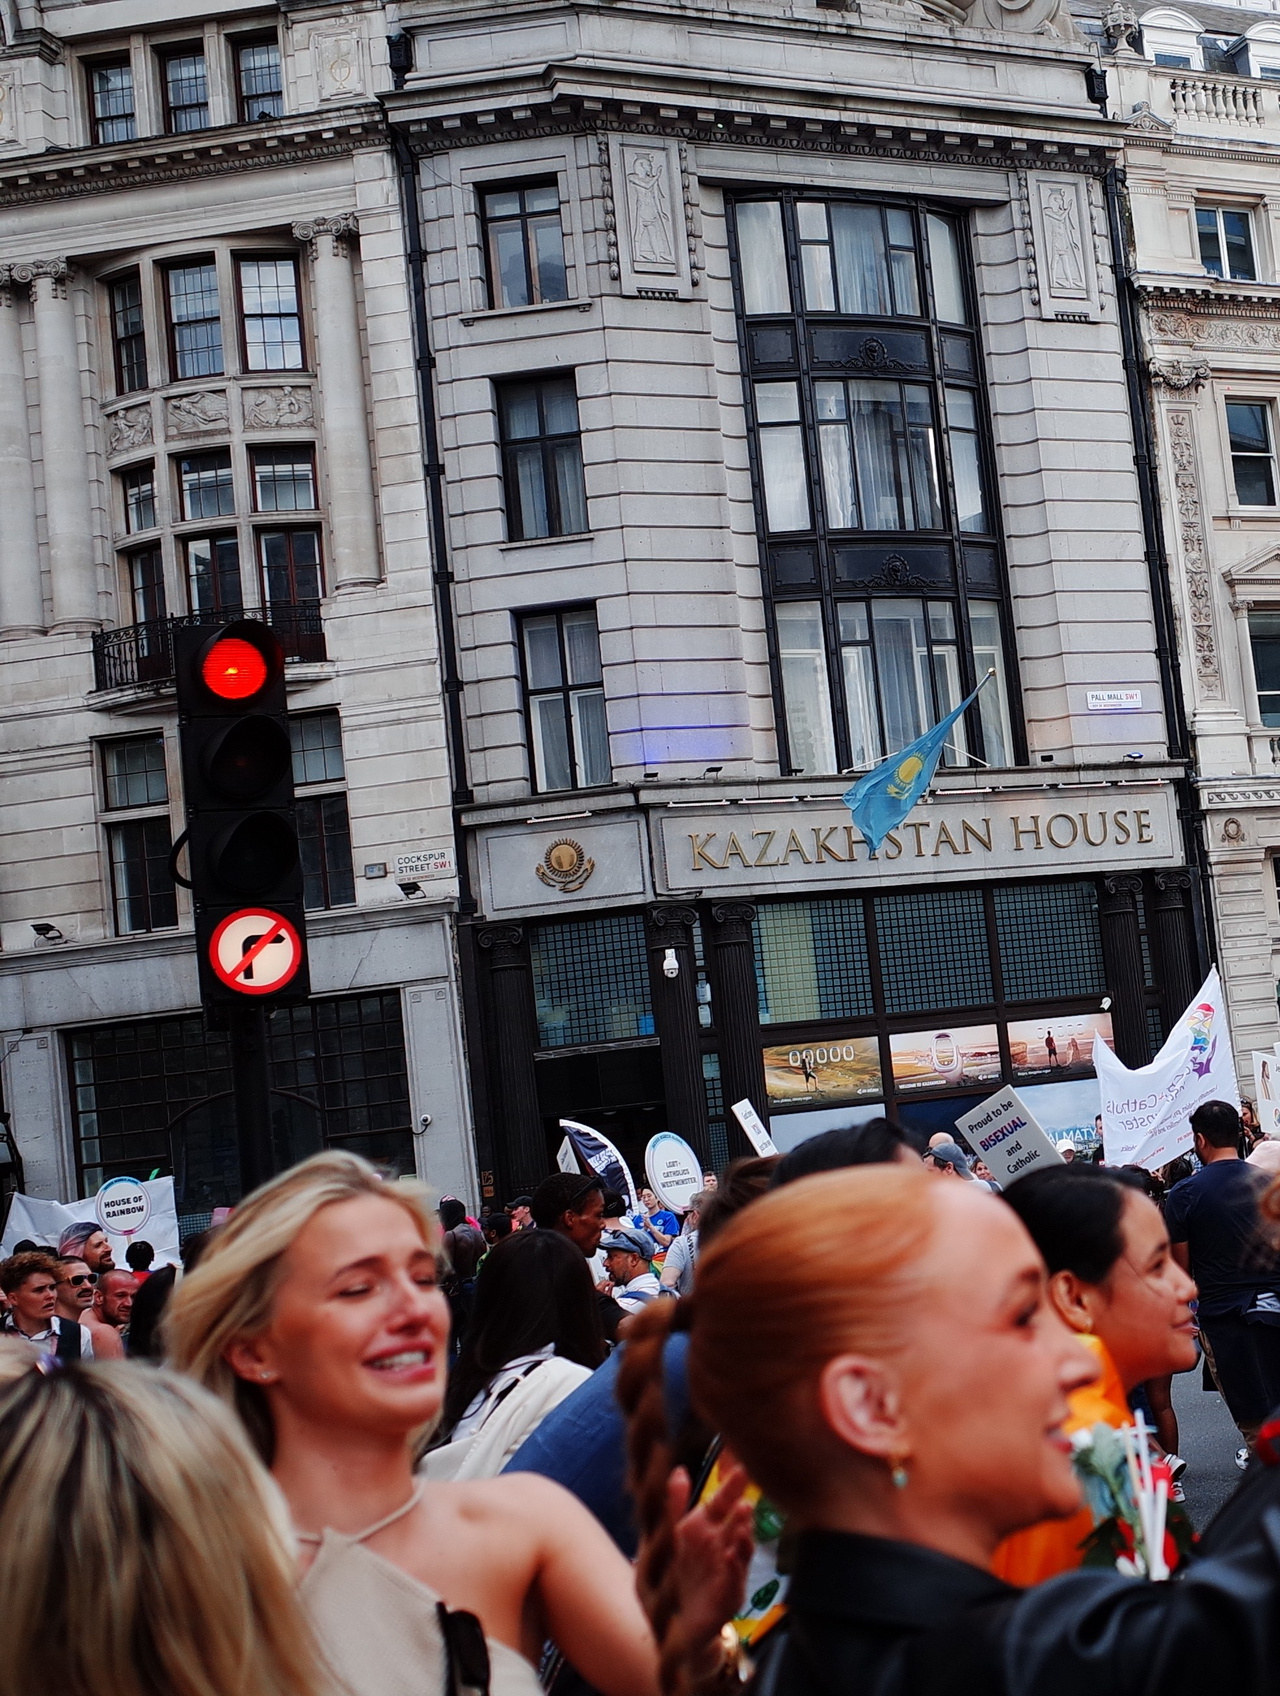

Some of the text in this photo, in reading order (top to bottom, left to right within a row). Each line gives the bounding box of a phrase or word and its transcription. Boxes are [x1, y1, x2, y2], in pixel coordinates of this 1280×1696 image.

[1107, 693, 1124, 701] MALL
[688, 809, 1154, 871] KAZAKHSTAN HOUSE
[397, 852, 446, 865] COCKSPUR
[398, 860, 452, 874] STREET SW1
[968, 1099, 1014, 1134] Proud to be
[979, 1116, 1027, 1152] BISEXUAL
[1005, 1141, 1023, 1157] and
[1007, 1149, 1041, 1175] Catholic
[663, 1169, 690, 1178] CATHOLICS
[661, 1177, 698, 1189] WESTMINSTER
[104, 1195, 143, 1209] HOUSE OF
[105, 1205, 144, 1219] RAINBOW
